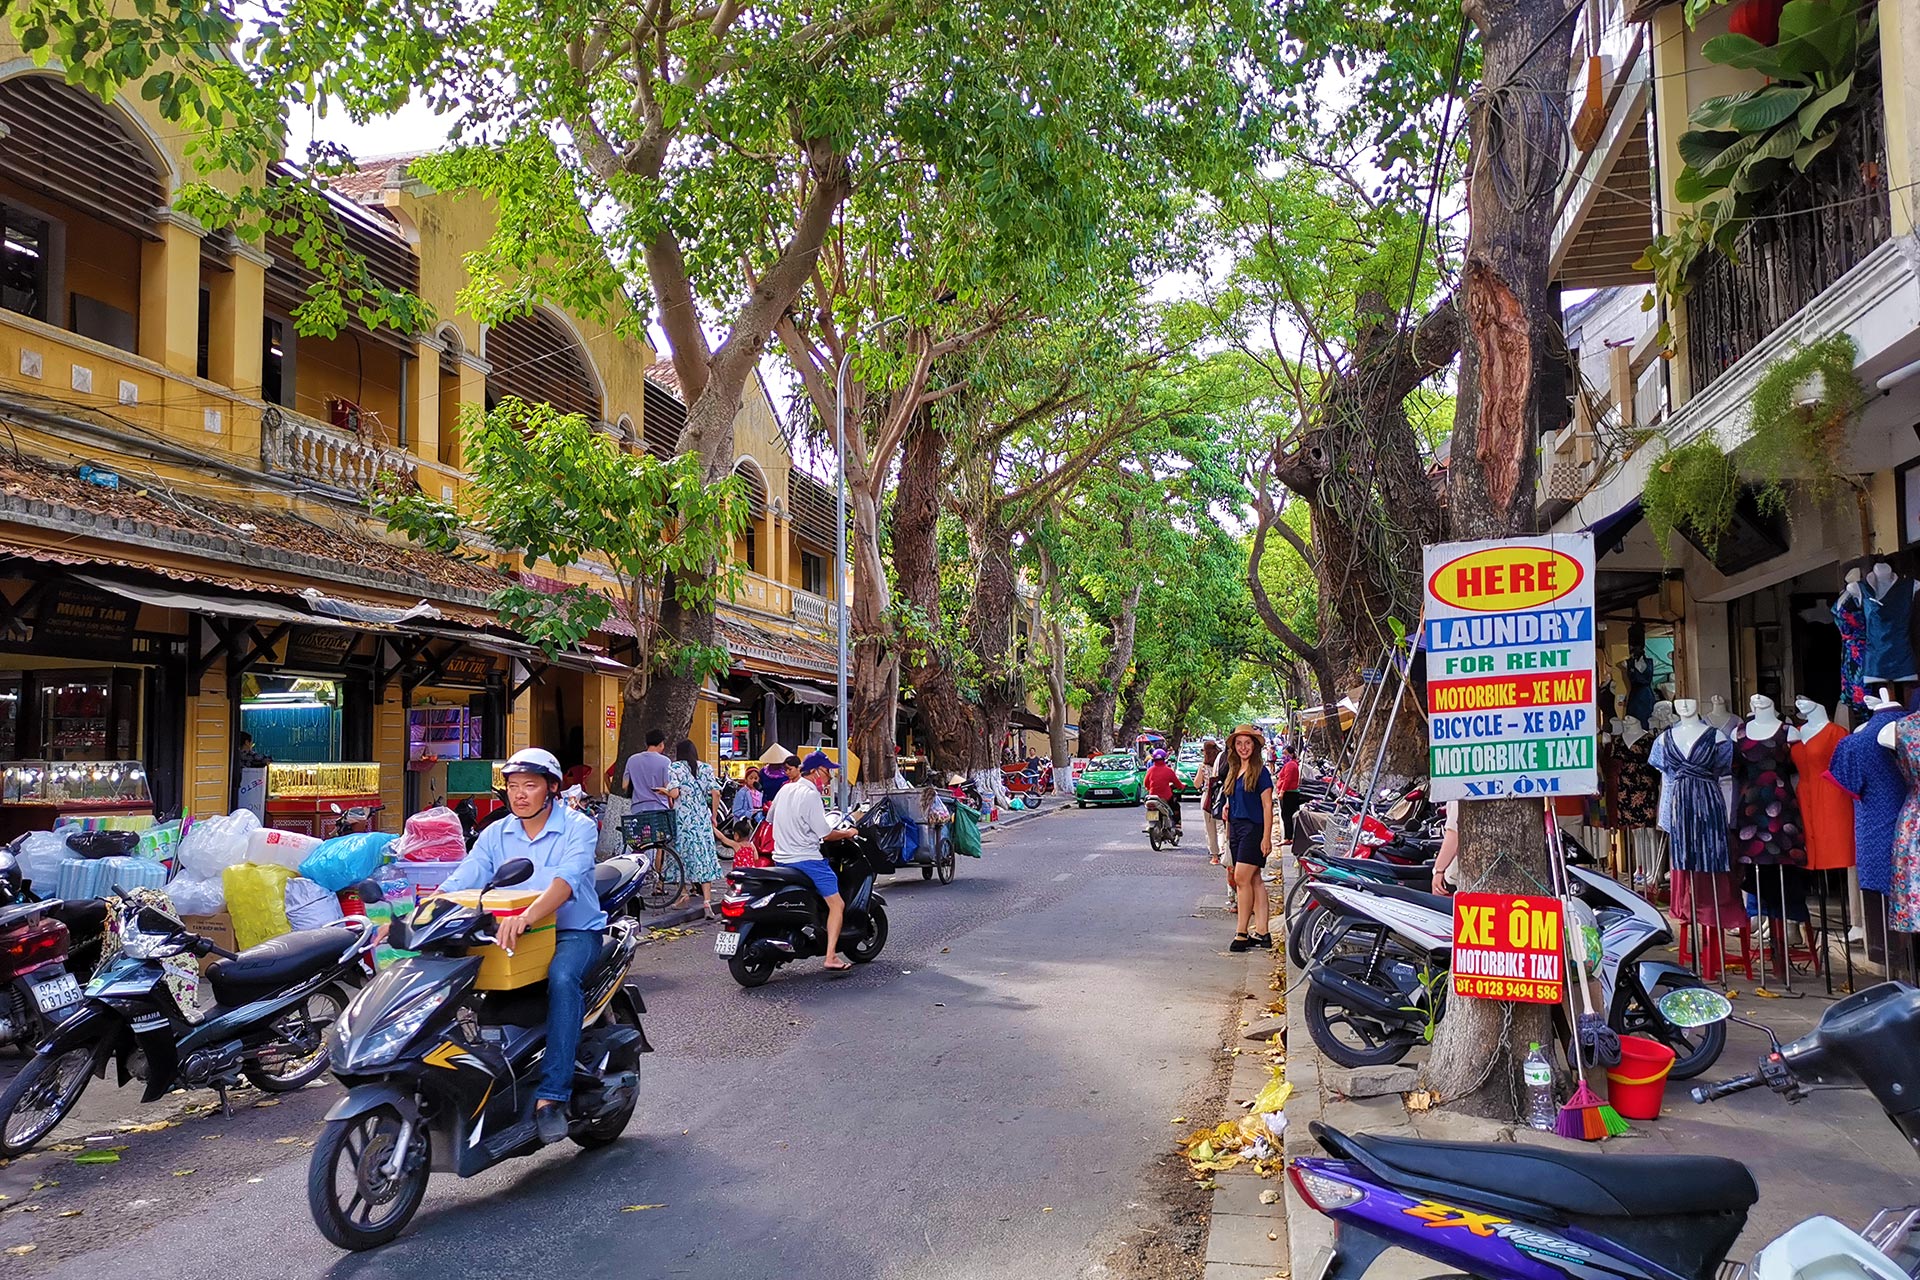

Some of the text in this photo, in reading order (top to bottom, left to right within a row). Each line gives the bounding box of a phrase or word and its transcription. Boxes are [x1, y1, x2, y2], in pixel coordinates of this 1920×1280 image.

[1457, 561, 1558, 598] HERE
[57, 602, 95, 618] MINH
[1431, 611, 1585, 650] LAUNDRY
[1446, 649, 1571, 675] FOR RENT
[1435, 682, 1517, 711] MOTORBIKE
[1532, 680, 1550, 704] XE
[1553, 673, 1585, 702] MÁY
[1433, 714, 1503, 740] BICYCLE
[1523, 711, 1544, 734] XE
[1548, 709, 1586, 736] ĐẠP
[1435, 739, 1587, 775] MOTORBIKE TAXI
[1463, 775, 1561, 797] XE ÔM
[1457, 905, 1496, 946] XE
[1509, 899, 1557, 950] ÔM
[1456, 948, 1558, 980] MOTORBIKE TAXI
[40, 988, 79, 1010] 087.95
[1476, 980, 1504, 996] 0128
[1506, 982, 1534, 998] 9494
[1536, 985, 1558, 1000] 586
[132, 1011, 161, 1023] YAMAHA
[1515, 1243, 1585, 1265] URBAN SPORTY MOVER
